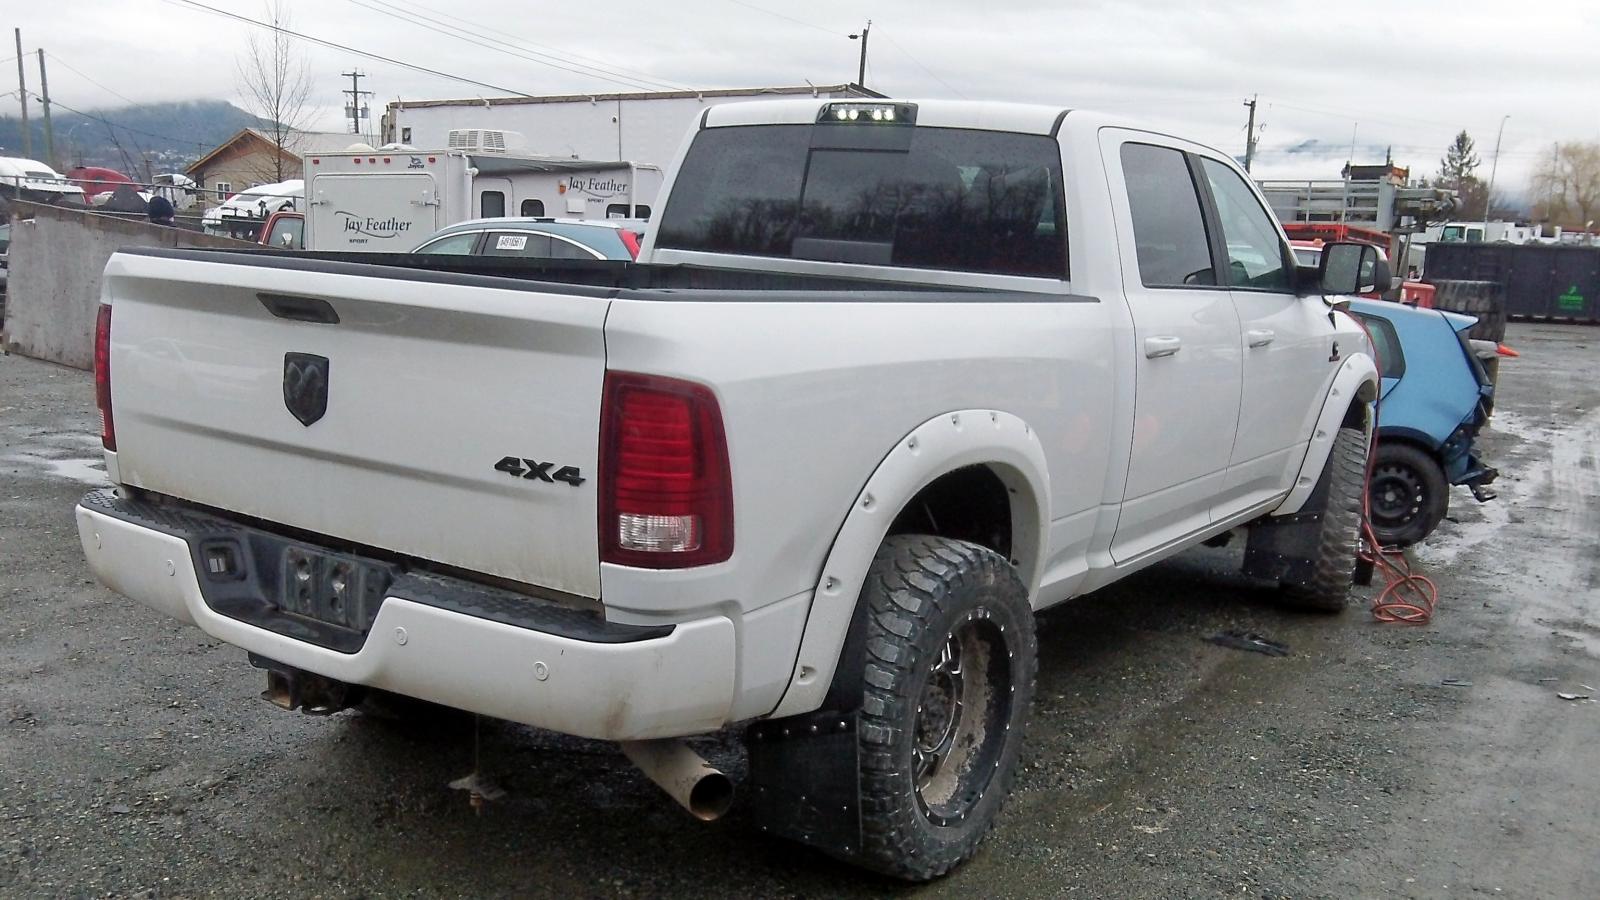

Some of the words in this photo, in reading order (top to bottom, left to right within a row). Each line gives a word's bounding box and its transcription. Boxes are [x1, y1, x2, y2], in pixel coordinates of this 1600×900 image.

[568, 176, 585, 193] Jay
[588, 178, 627, 192] Feather
[344, 217, 362, 236] Jay
[366, 217, 412, 231] Feather
